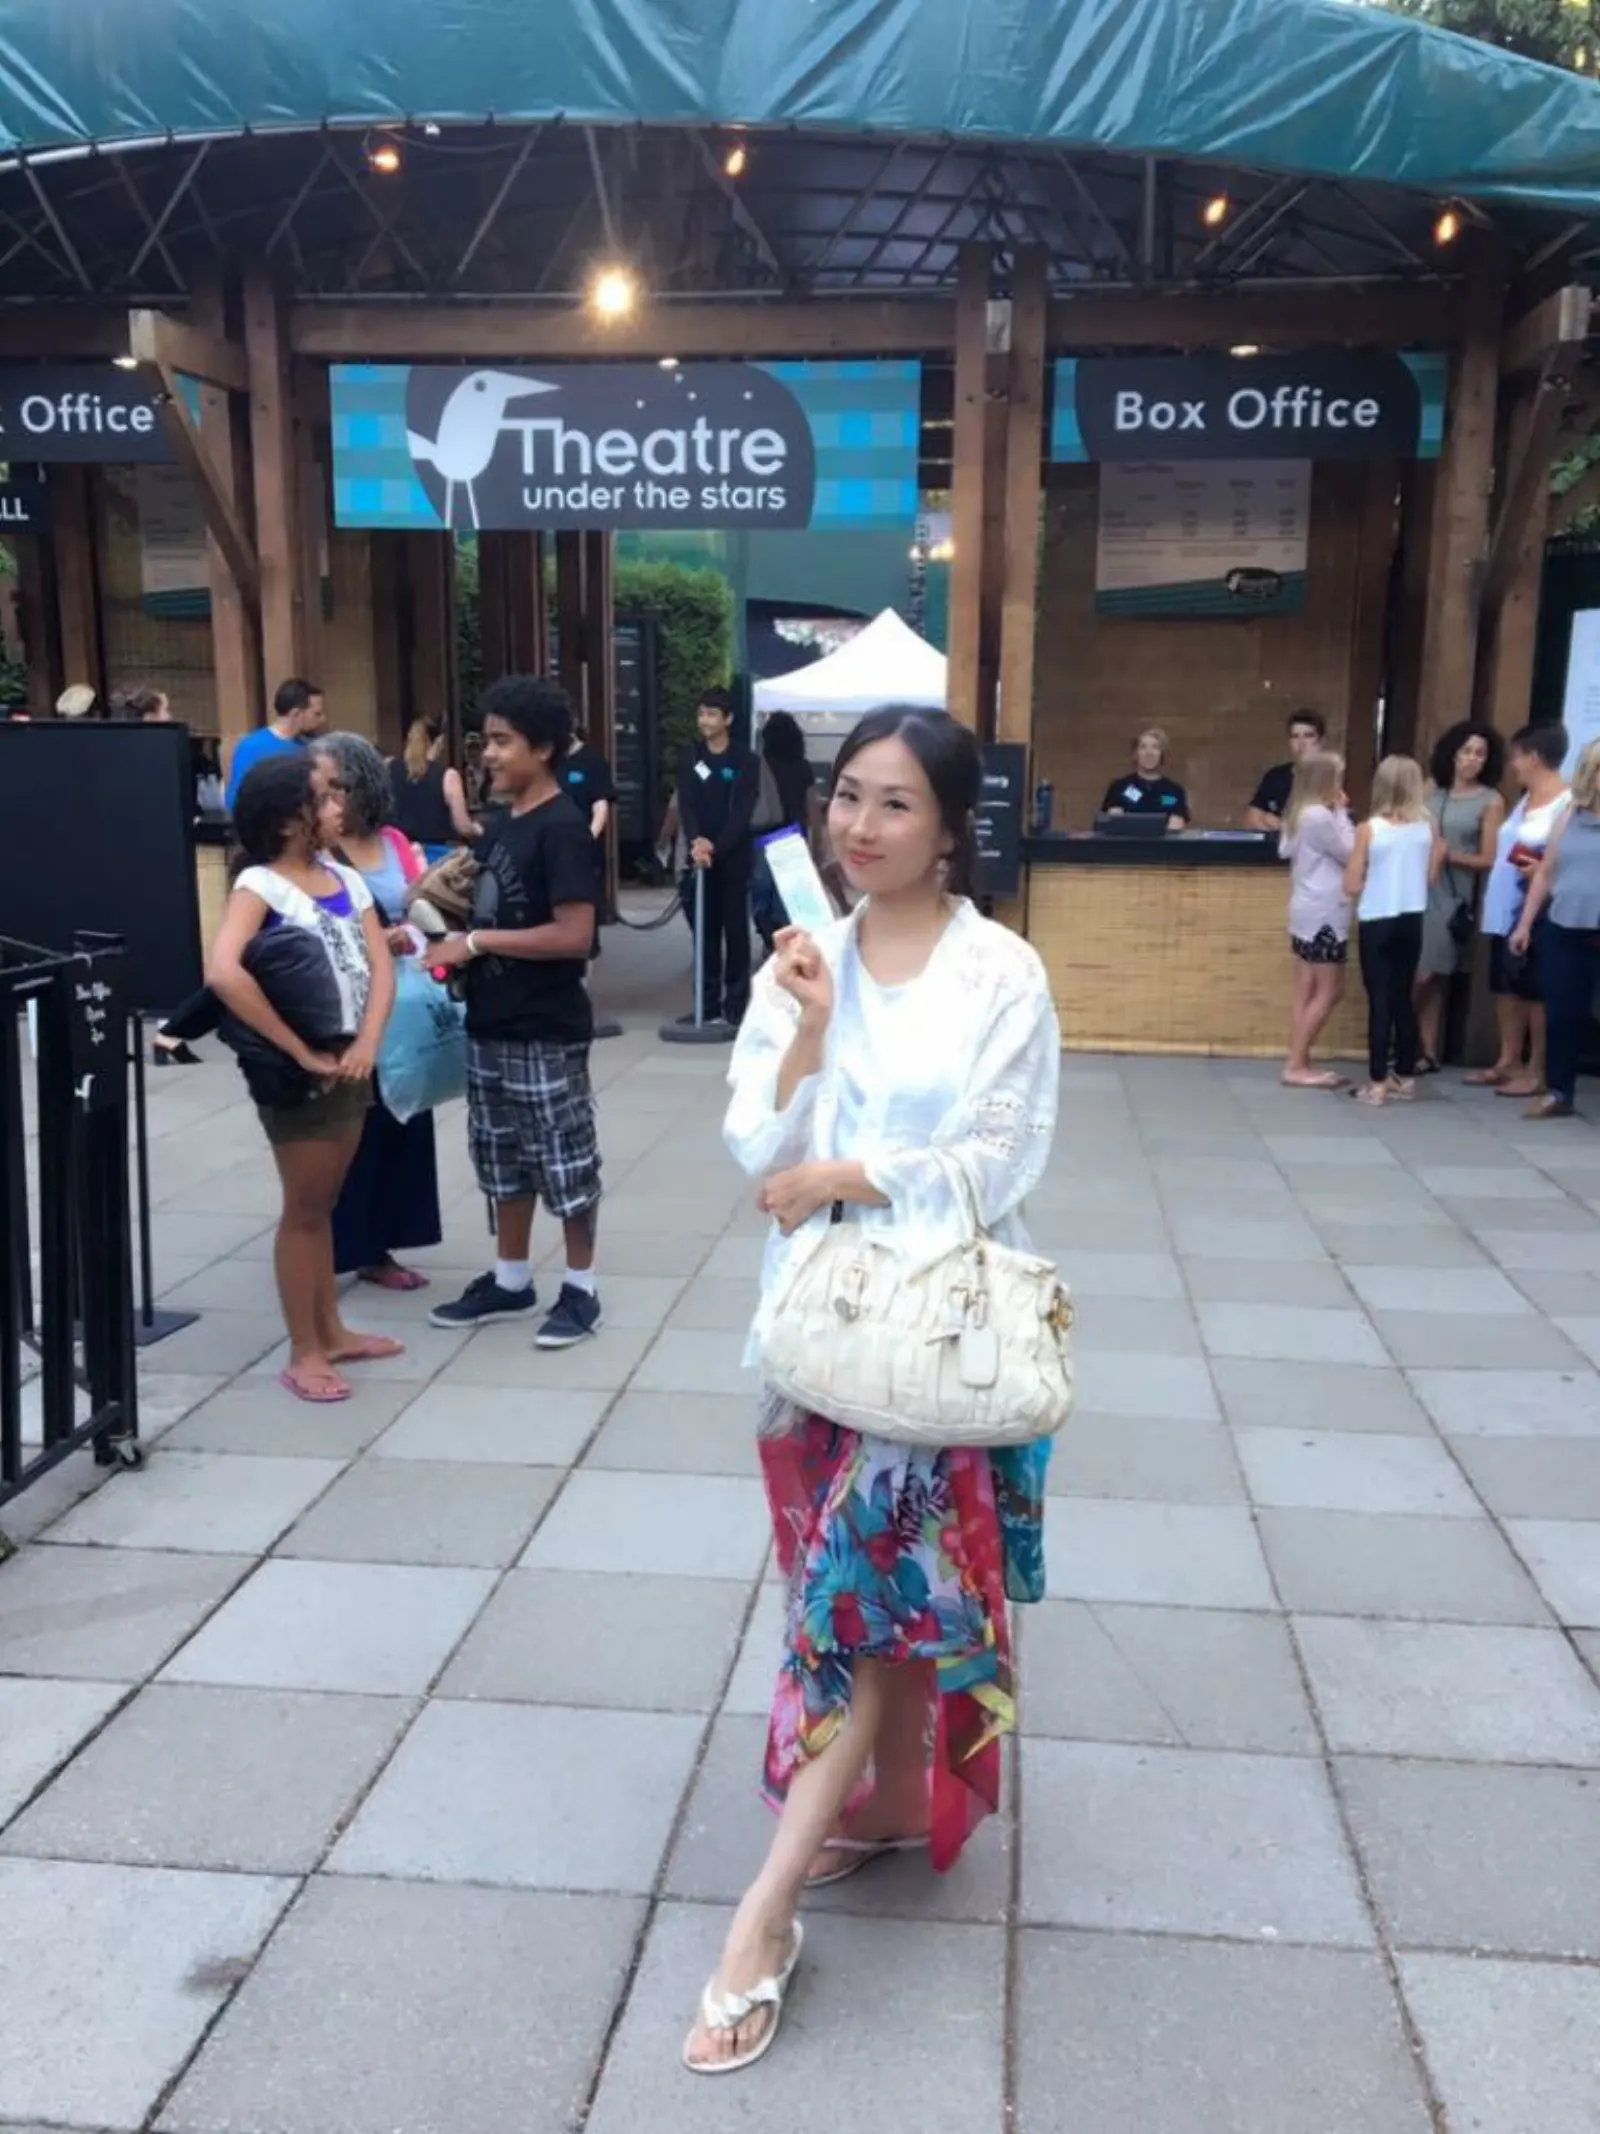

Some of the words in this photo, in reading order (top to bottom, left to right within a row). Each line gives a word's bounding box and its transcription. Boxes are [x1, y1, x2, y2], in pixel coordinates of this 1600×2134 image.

[20, 392, 155, 433] Office
[1115, 390, 1206, 431] Box
[1227, 386, 1380, 430] Office
[503, 416, 787, 476] Theatre
[0, 496, 30, 522] LL
[522, 480, 625, 510] under
[633, 479, 691, 510] the
[700, 480, 787, 510] stars
